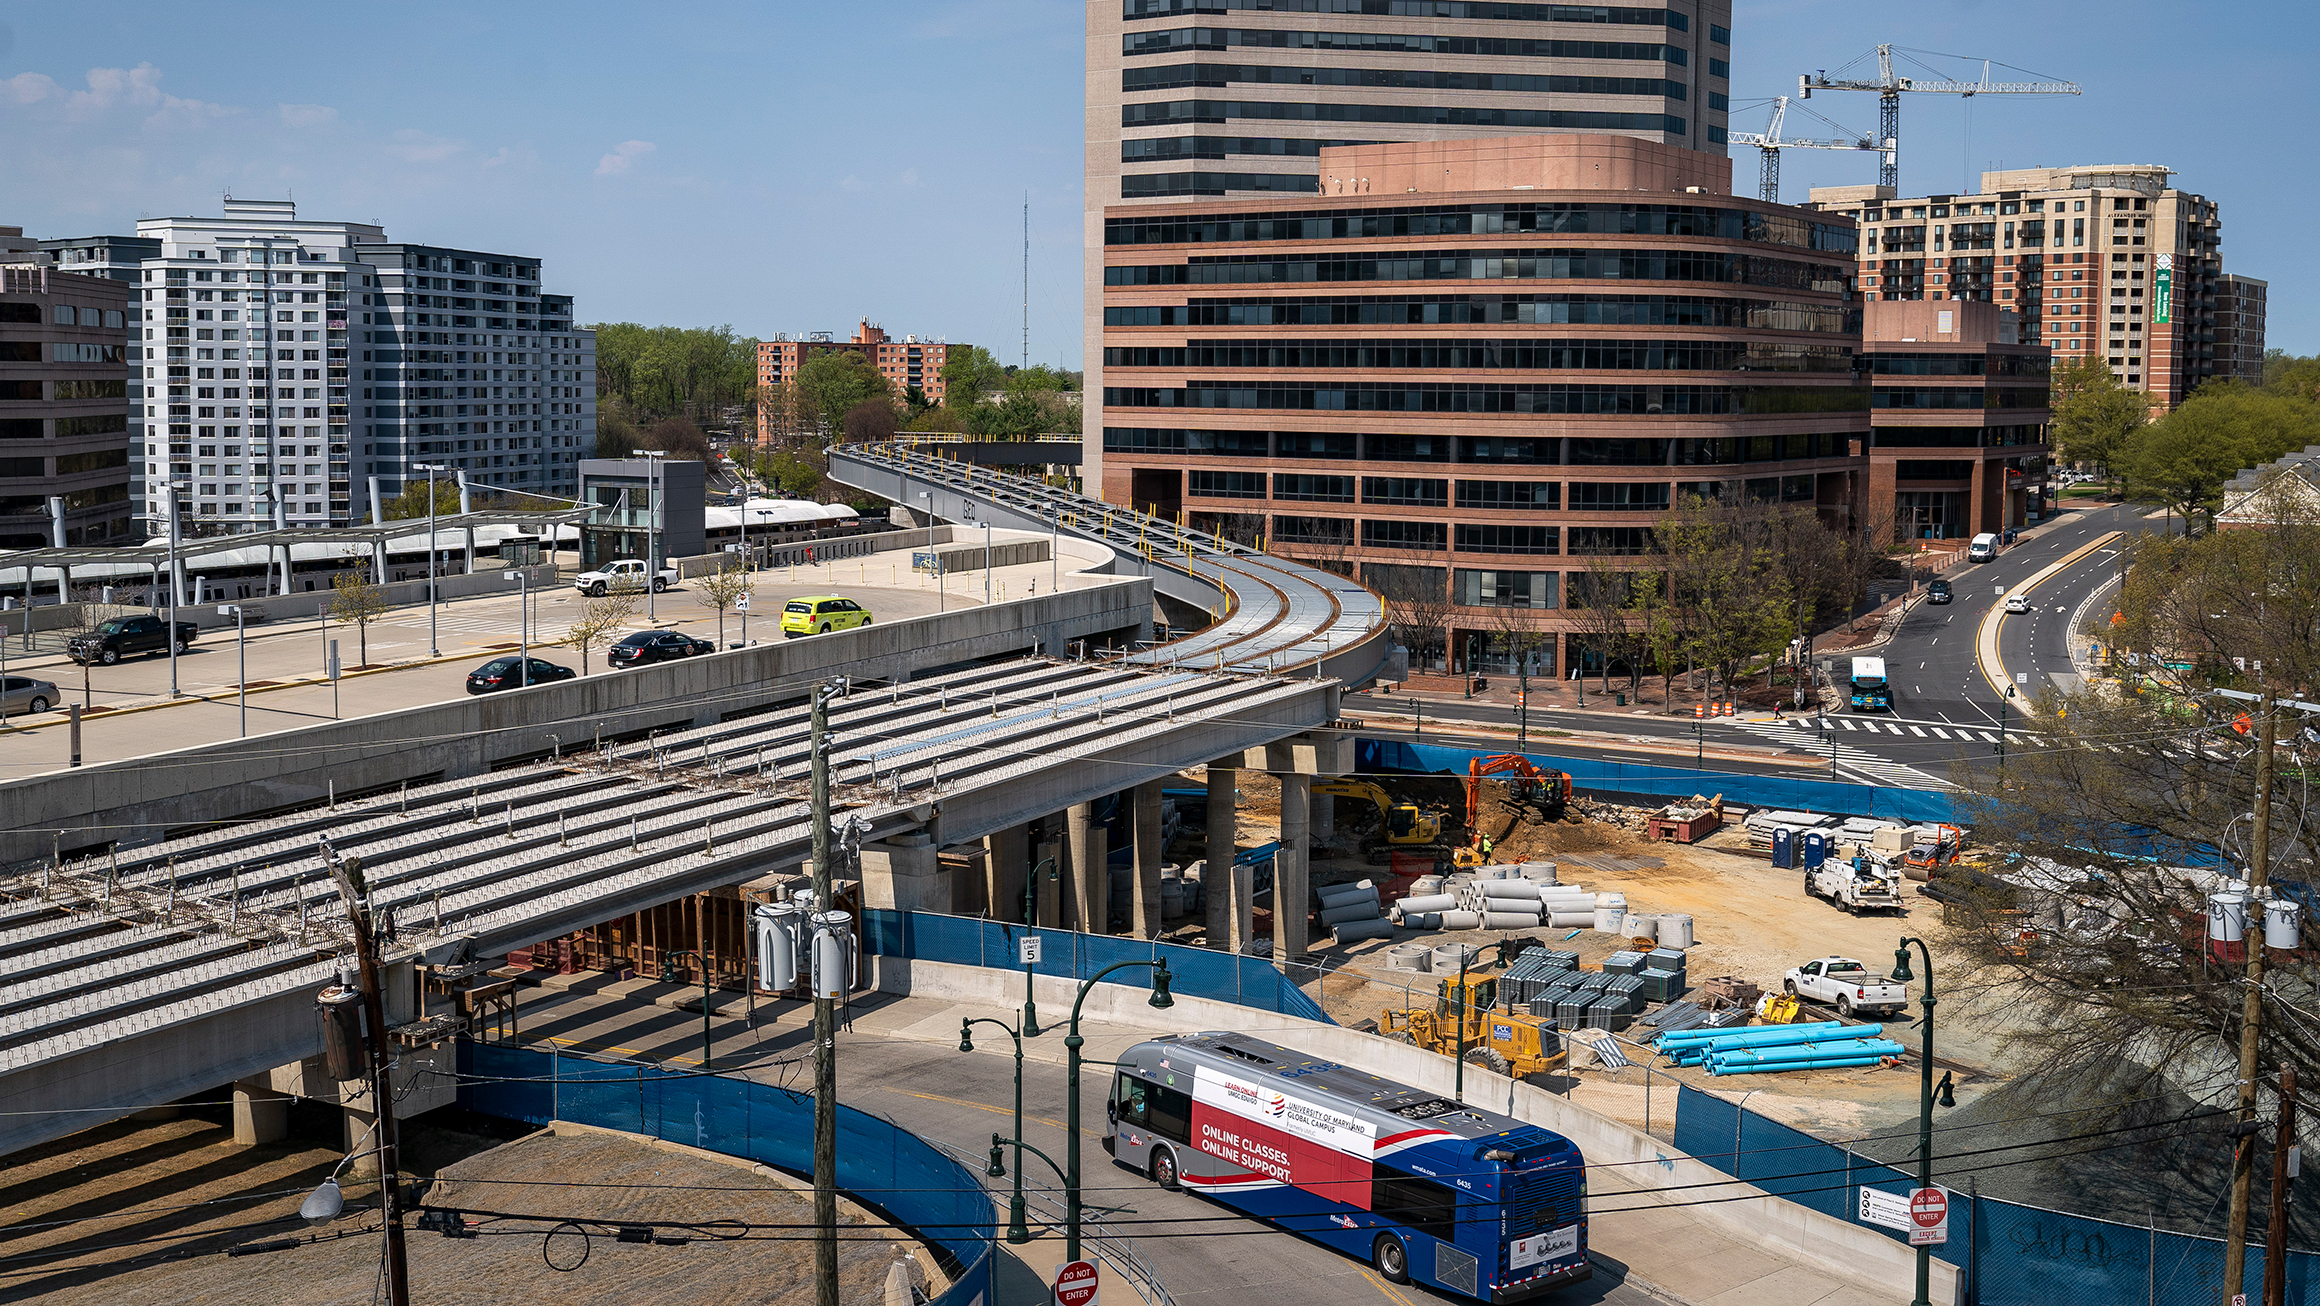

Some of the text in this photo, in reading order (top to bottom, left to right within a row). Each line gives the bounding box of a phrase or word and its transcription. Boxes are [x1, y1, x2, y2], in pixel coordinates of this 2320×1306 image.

[1027, 950, 1035, 960] 5
[1146, 1070, 1157, 1079] 6435
[1280, 1062, 1342, 1078] 6435
[1225, 1082, 1258, 1098] LEARN ONLINE
[1287, 1111, 1336, 1134] GLOBAL CAMPUS
[1289, 1102, 1365, 1133] UNIVERSITY OF MARYLAND
[1202, 1124, 1291, 1166] ONLINE CLASSES.
[1201, 1139, 1293, 1183] ONLINE SUPPORT.
[1412, 1164, 1437, 1177] wmata.com
[1456, 1179, 1472, 1190] 6435
[1928, 1195, 1940, 1203] NOT
[1330, 1214, 1344, 1225] Metro
[1919, 1213, 1939, 1221] ENTER
[1064, 1268, 1090, 1280] DO NOT
[1066, 1289, 1089, 1300] ENTER
